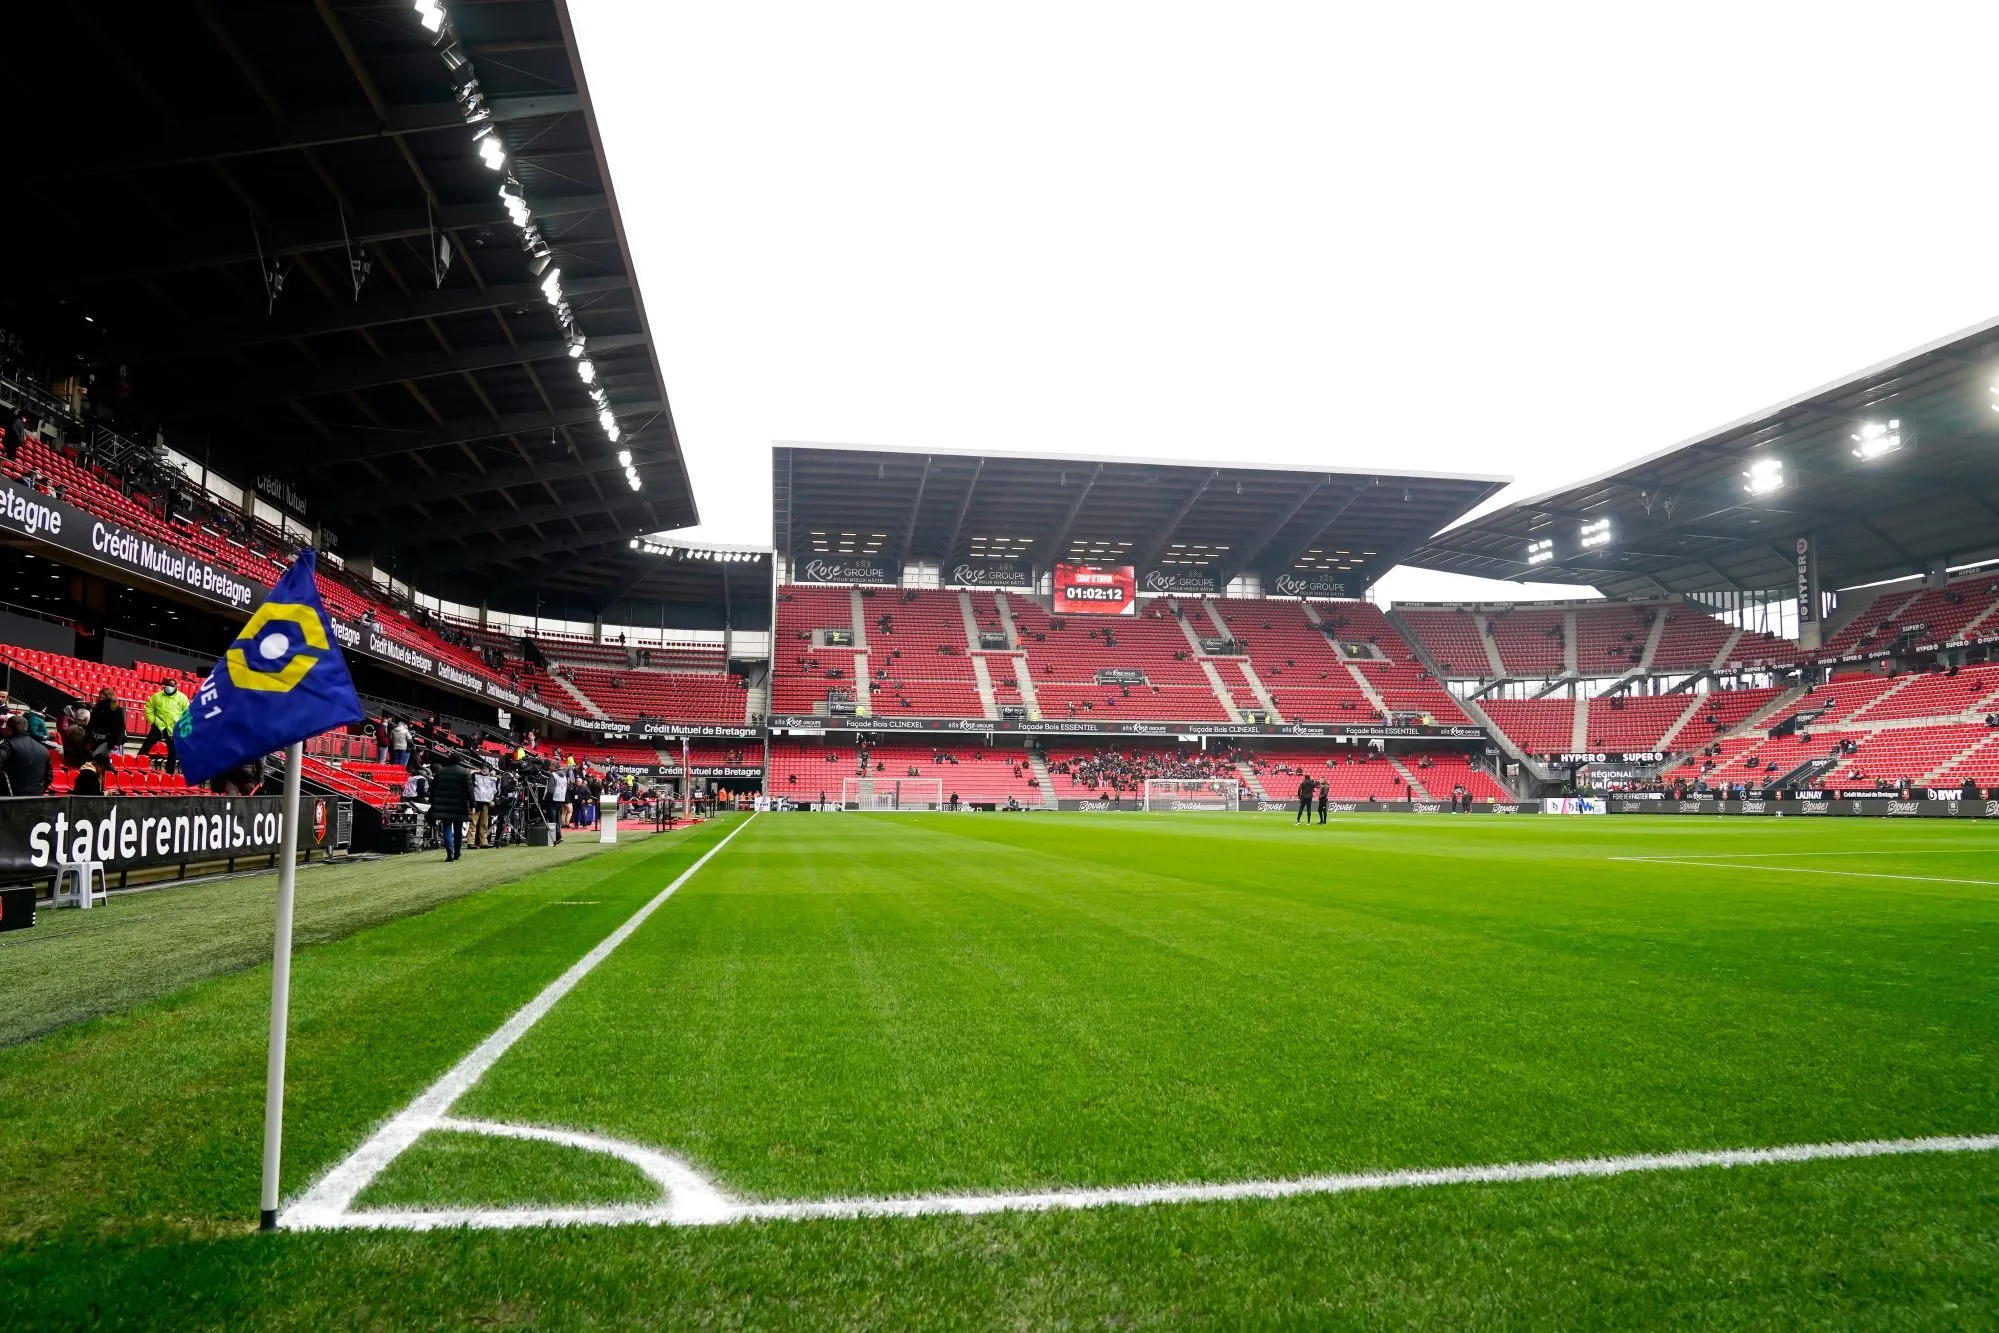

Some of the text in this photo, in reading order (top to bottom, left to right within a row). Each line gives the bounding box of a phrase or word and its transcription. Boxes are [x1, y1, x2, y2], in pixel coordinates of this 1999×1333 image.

[92, 522, 252, 607] Crédit Mutuel de Bretagne
[805, 559, 884, 581] Rose GROUPE
[953, 564, 1025, 585] Rose GROUPE
[1798, 555, 1808, 604] HYPER
[1145, 570, 1214, 591] Rose GROUPE
[1275, 573, 1345, 595] Rose GROUPE
[1066, 587, 1123, 600] 01:02:12
[330, 617, 361, 647] Bretagne
[1902, 624, 1919, 632] SUPER
[369, 633, 432, 673] Crédit Mutuel de Bretagne
[601, 721, 631, 732] Bretagne
[846, 720, 872, 728] Façade
[873, 720, 888, 728] Bois
[960, 719, 976, 731] Rose
[1018, 723, 1043, 731] Façade
[1060, 723, 1098, 731] ESSENTIEL
[1132, 722, 1148, 733] Rose
[1189, 725, 1213, 734] Façade
[644, 723, 757, 737] Crédit Mutuel de Bretagne
[1346, 727, 1370, 735] Façade
[1450, 726, 1465, 737] Rose
[1561, 754, 1595, 762] HYPER
[1622, 753, 1654, 761] SUPER
[619, 765, 649, 774] Bretagne
[659, 766, 761, 777] Crédit utuel de Bretagne
[1591, 770, 1632, 778] RÉGIONAL
[1795, 791, 1823, 799] LAUNAY
[1937, 790, 1962, 800] BWT
[1079, 800, 1109, 811] BOUGE!
[1257, 801, 1286, 812] BOUGE!
[1327, 802, 1357, 812] BOUGE!
[1412, 803, 1440, 813] BOUGE!
[1492, 804, 1519, 814] BOUGE!
[1742, 801, 1766, 814] BOUGE!
[1802, 800, 1829, 814] BOUGE!
[1887, 800, 1919, 815] BOUGE!
